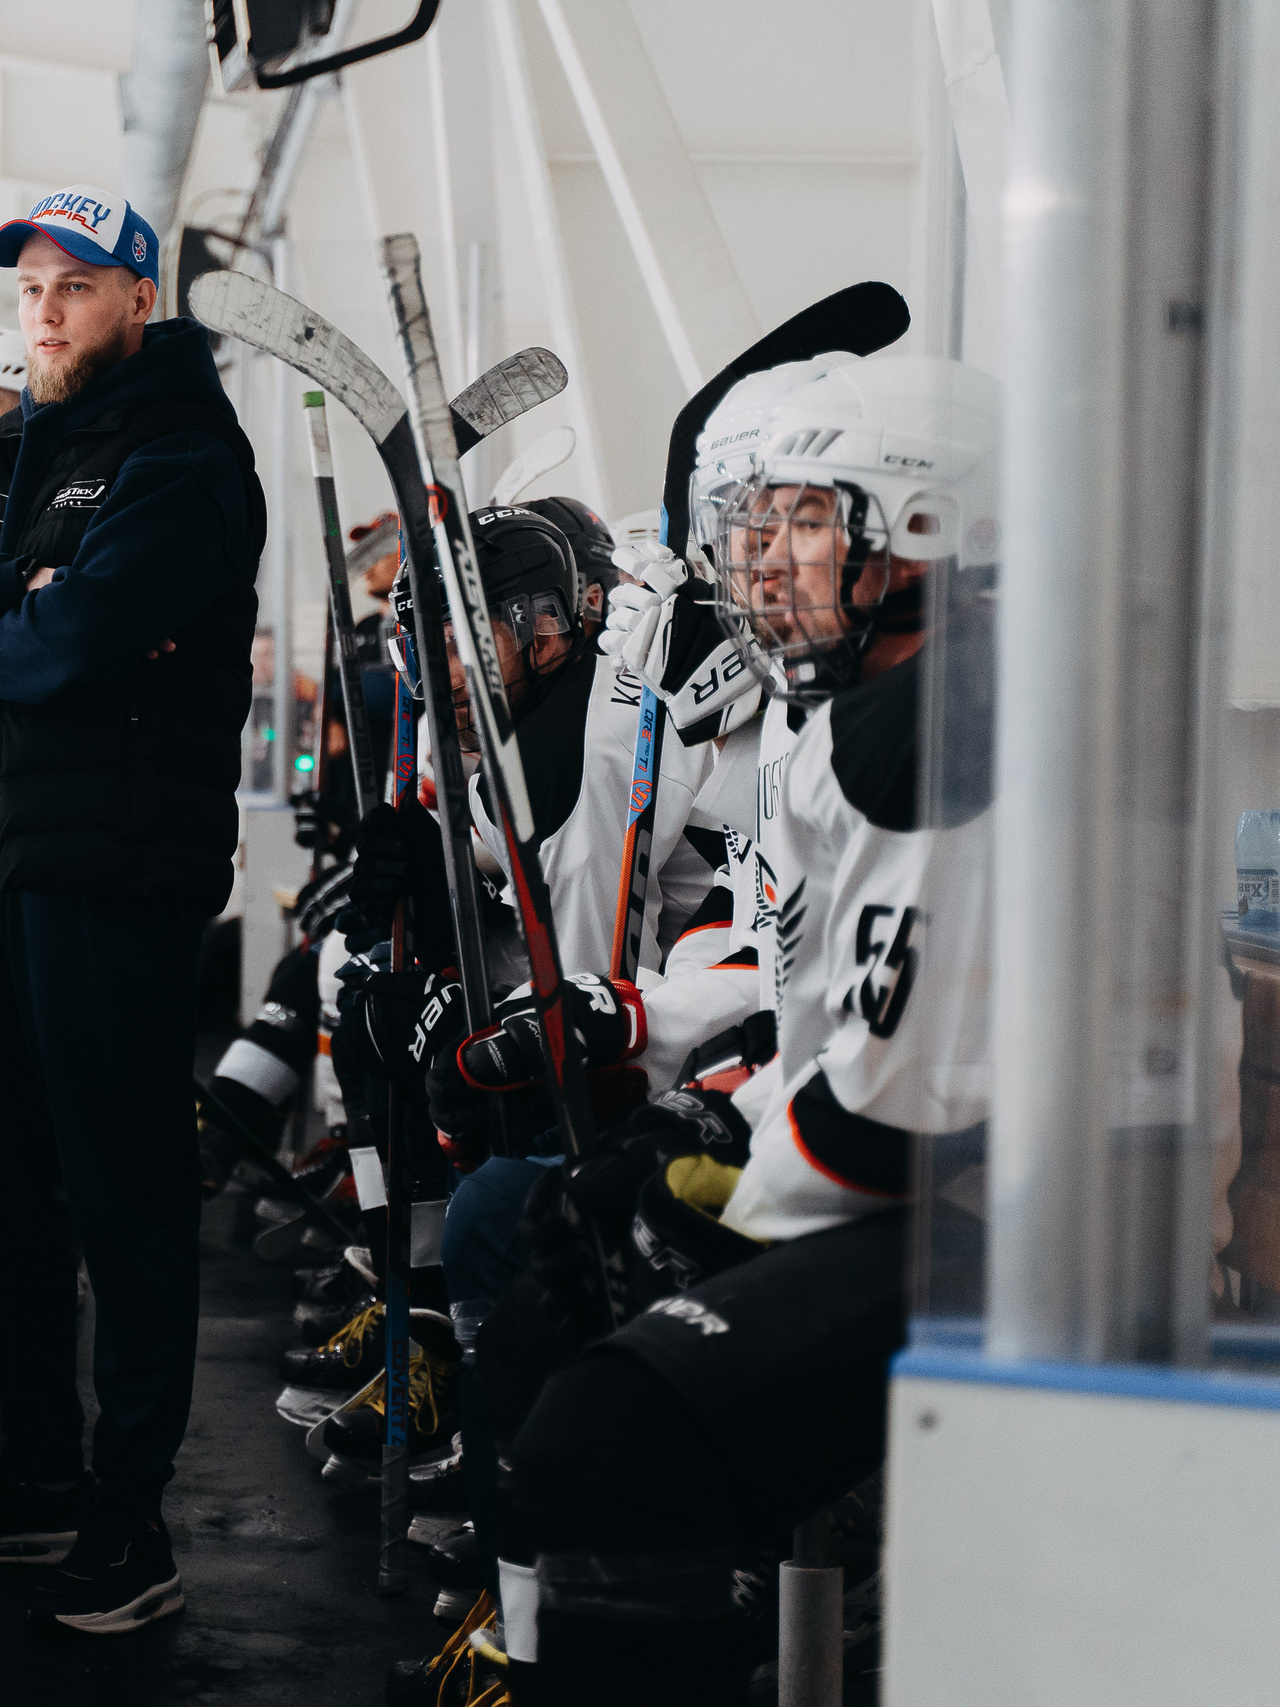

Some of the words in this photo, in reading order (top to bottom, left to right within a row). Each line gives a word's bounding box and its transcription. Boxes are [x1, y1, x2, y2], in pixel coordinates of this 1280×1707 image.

[28, 192, 111, 228] HOCKEY
[477, 508, 530, 526] CCM
[397, 599, 414, 612] CC
[391, 1339, 407, 1432] COVERT
